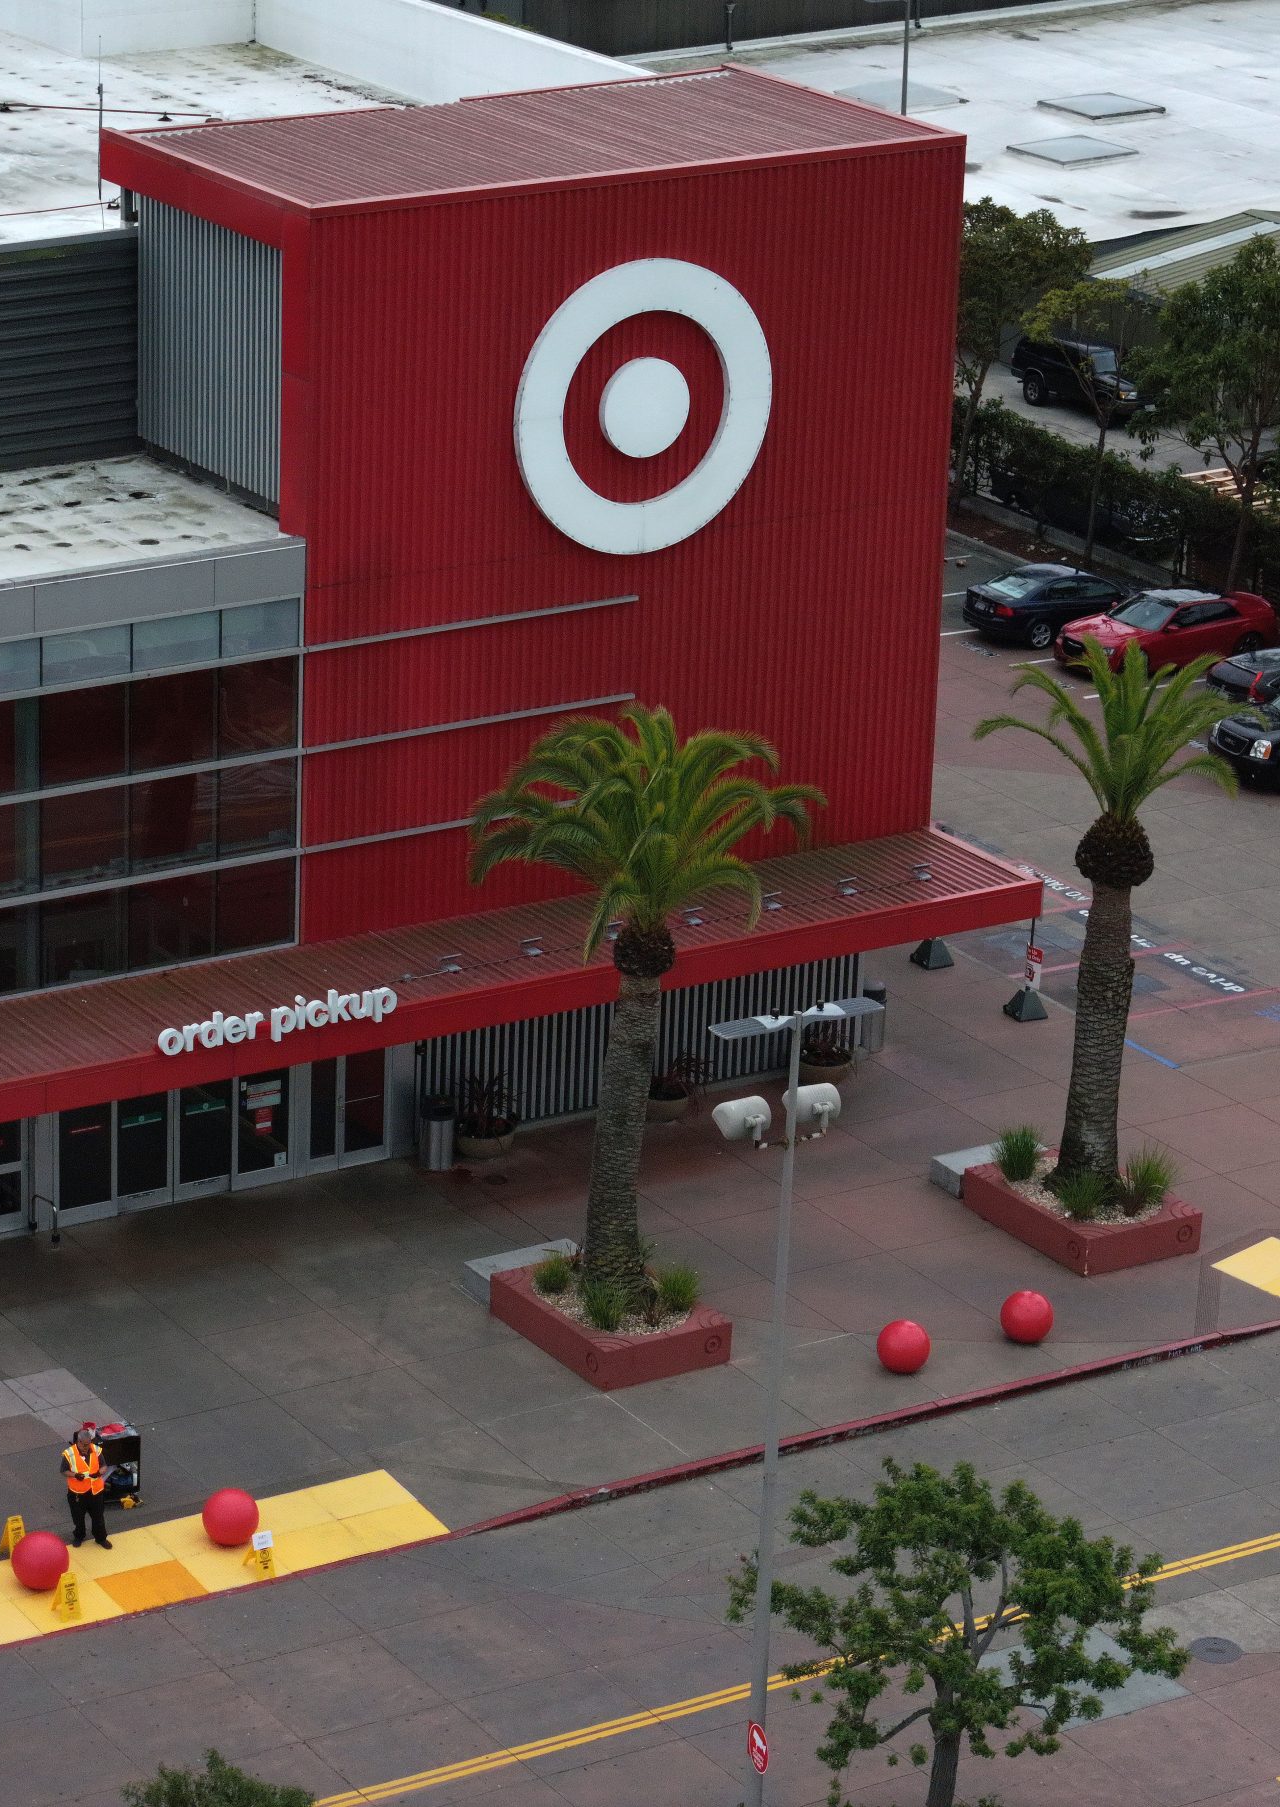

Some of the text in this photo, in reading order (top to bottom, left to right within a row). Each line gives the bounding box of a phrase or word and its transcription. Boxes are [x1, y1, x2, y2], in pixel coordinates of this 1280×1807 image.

[1163, 952, 1191, 966] up
[158, 987, 398, 1056] order pickup
